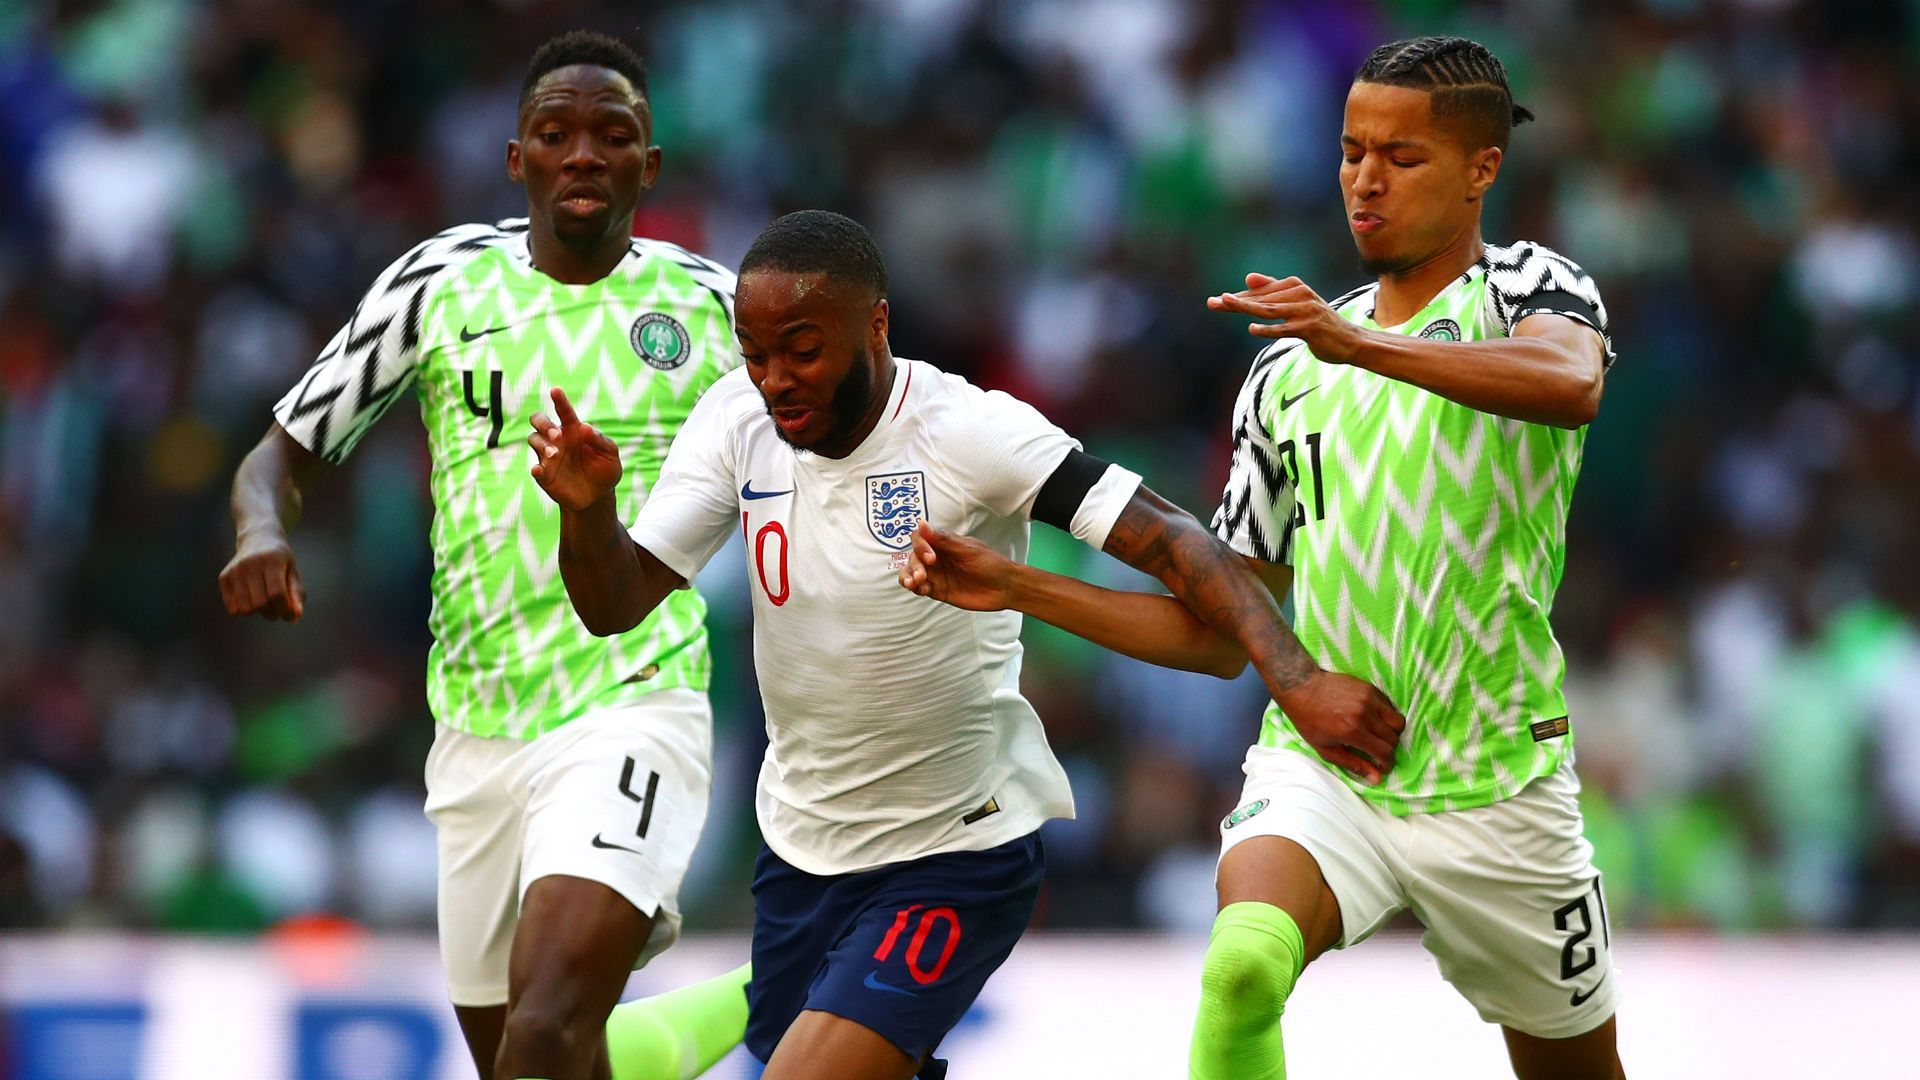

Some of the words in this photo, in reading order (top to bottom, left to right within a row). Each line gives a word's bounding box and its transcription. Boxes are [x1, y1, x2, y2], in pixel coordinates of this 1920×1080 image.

[463, 370, 503, 449] 4
[1277, 432, 1325, 528] 21
[742, 511, 789, 606] 10
[619, 755, 660, 840] 4
[873, 904, 961, 985] 10
[1553, 875, 1608, 981] 21
